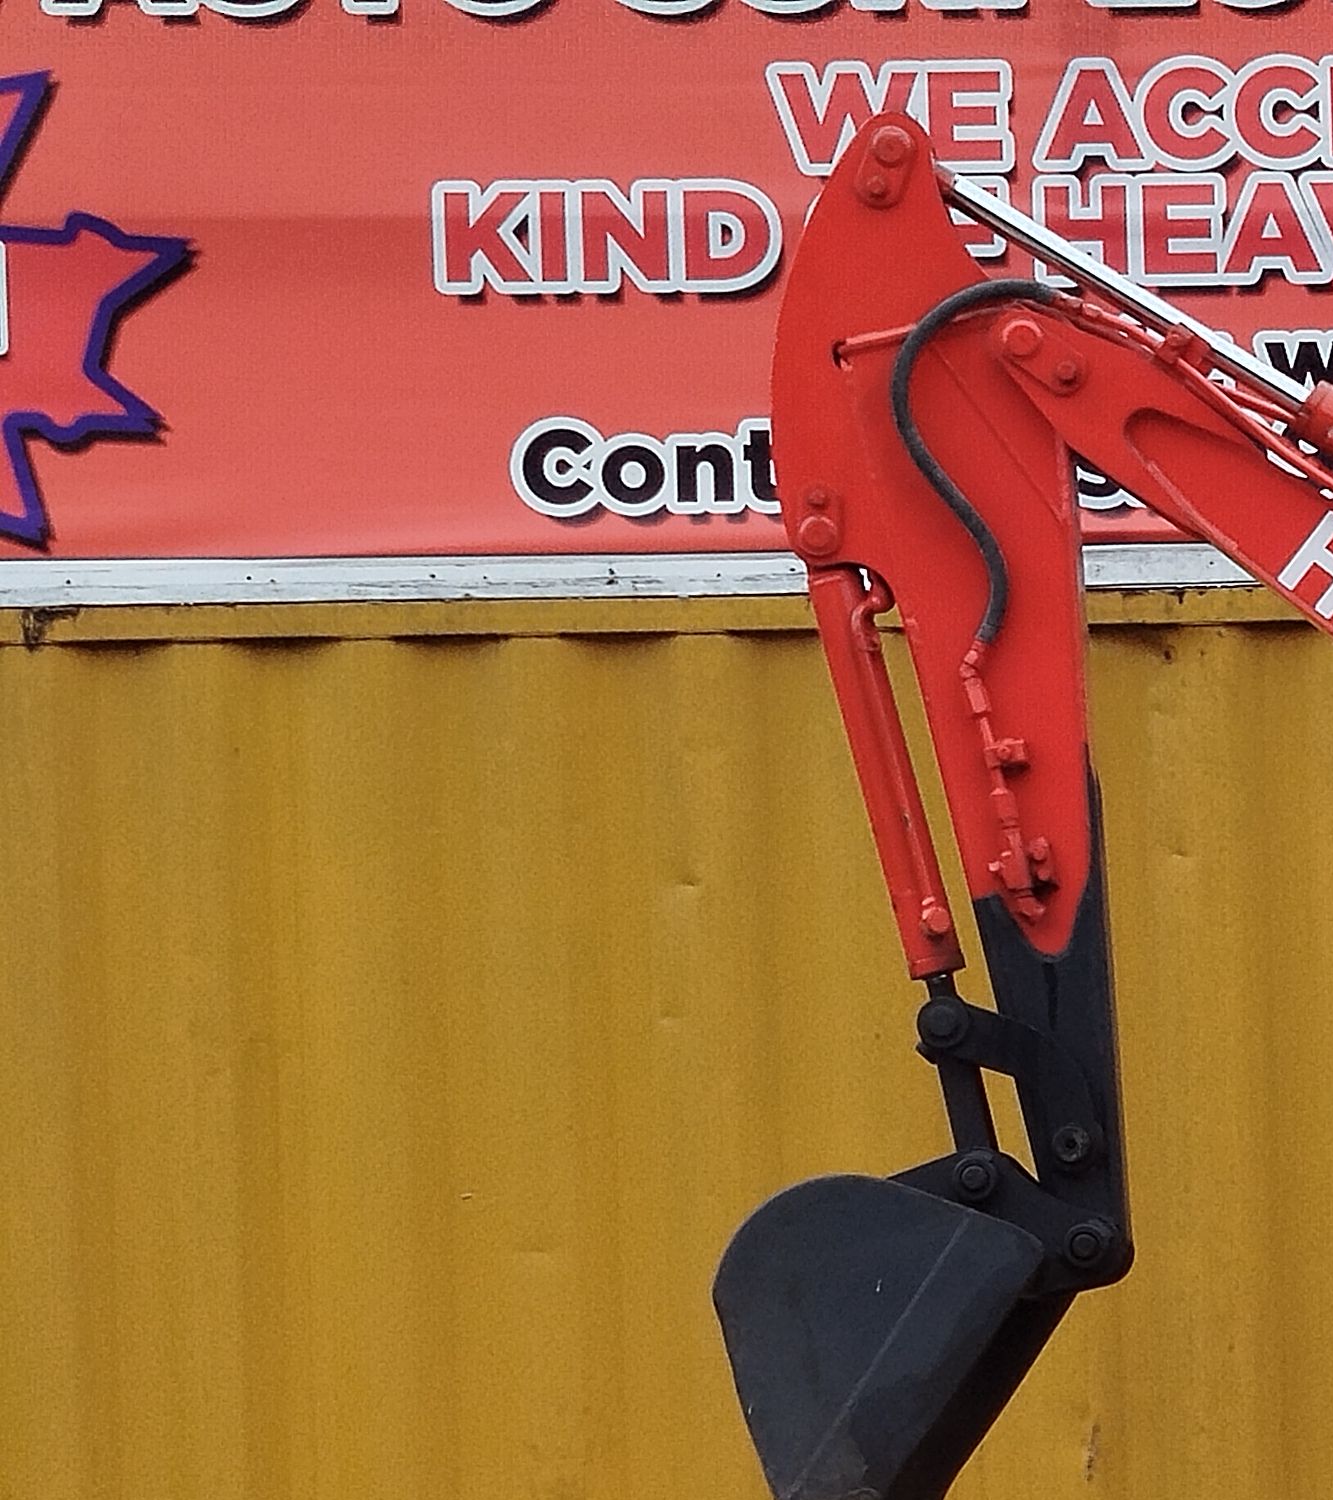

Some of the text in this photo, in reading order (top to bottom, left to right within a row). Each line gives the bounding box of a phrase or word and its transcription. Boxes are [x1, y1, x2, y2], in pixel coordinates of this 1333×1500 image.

[766, 58, 1014, 176] WE
[431, 179, 782, 295] KIND
[511, 416, 783, 517] Cont
